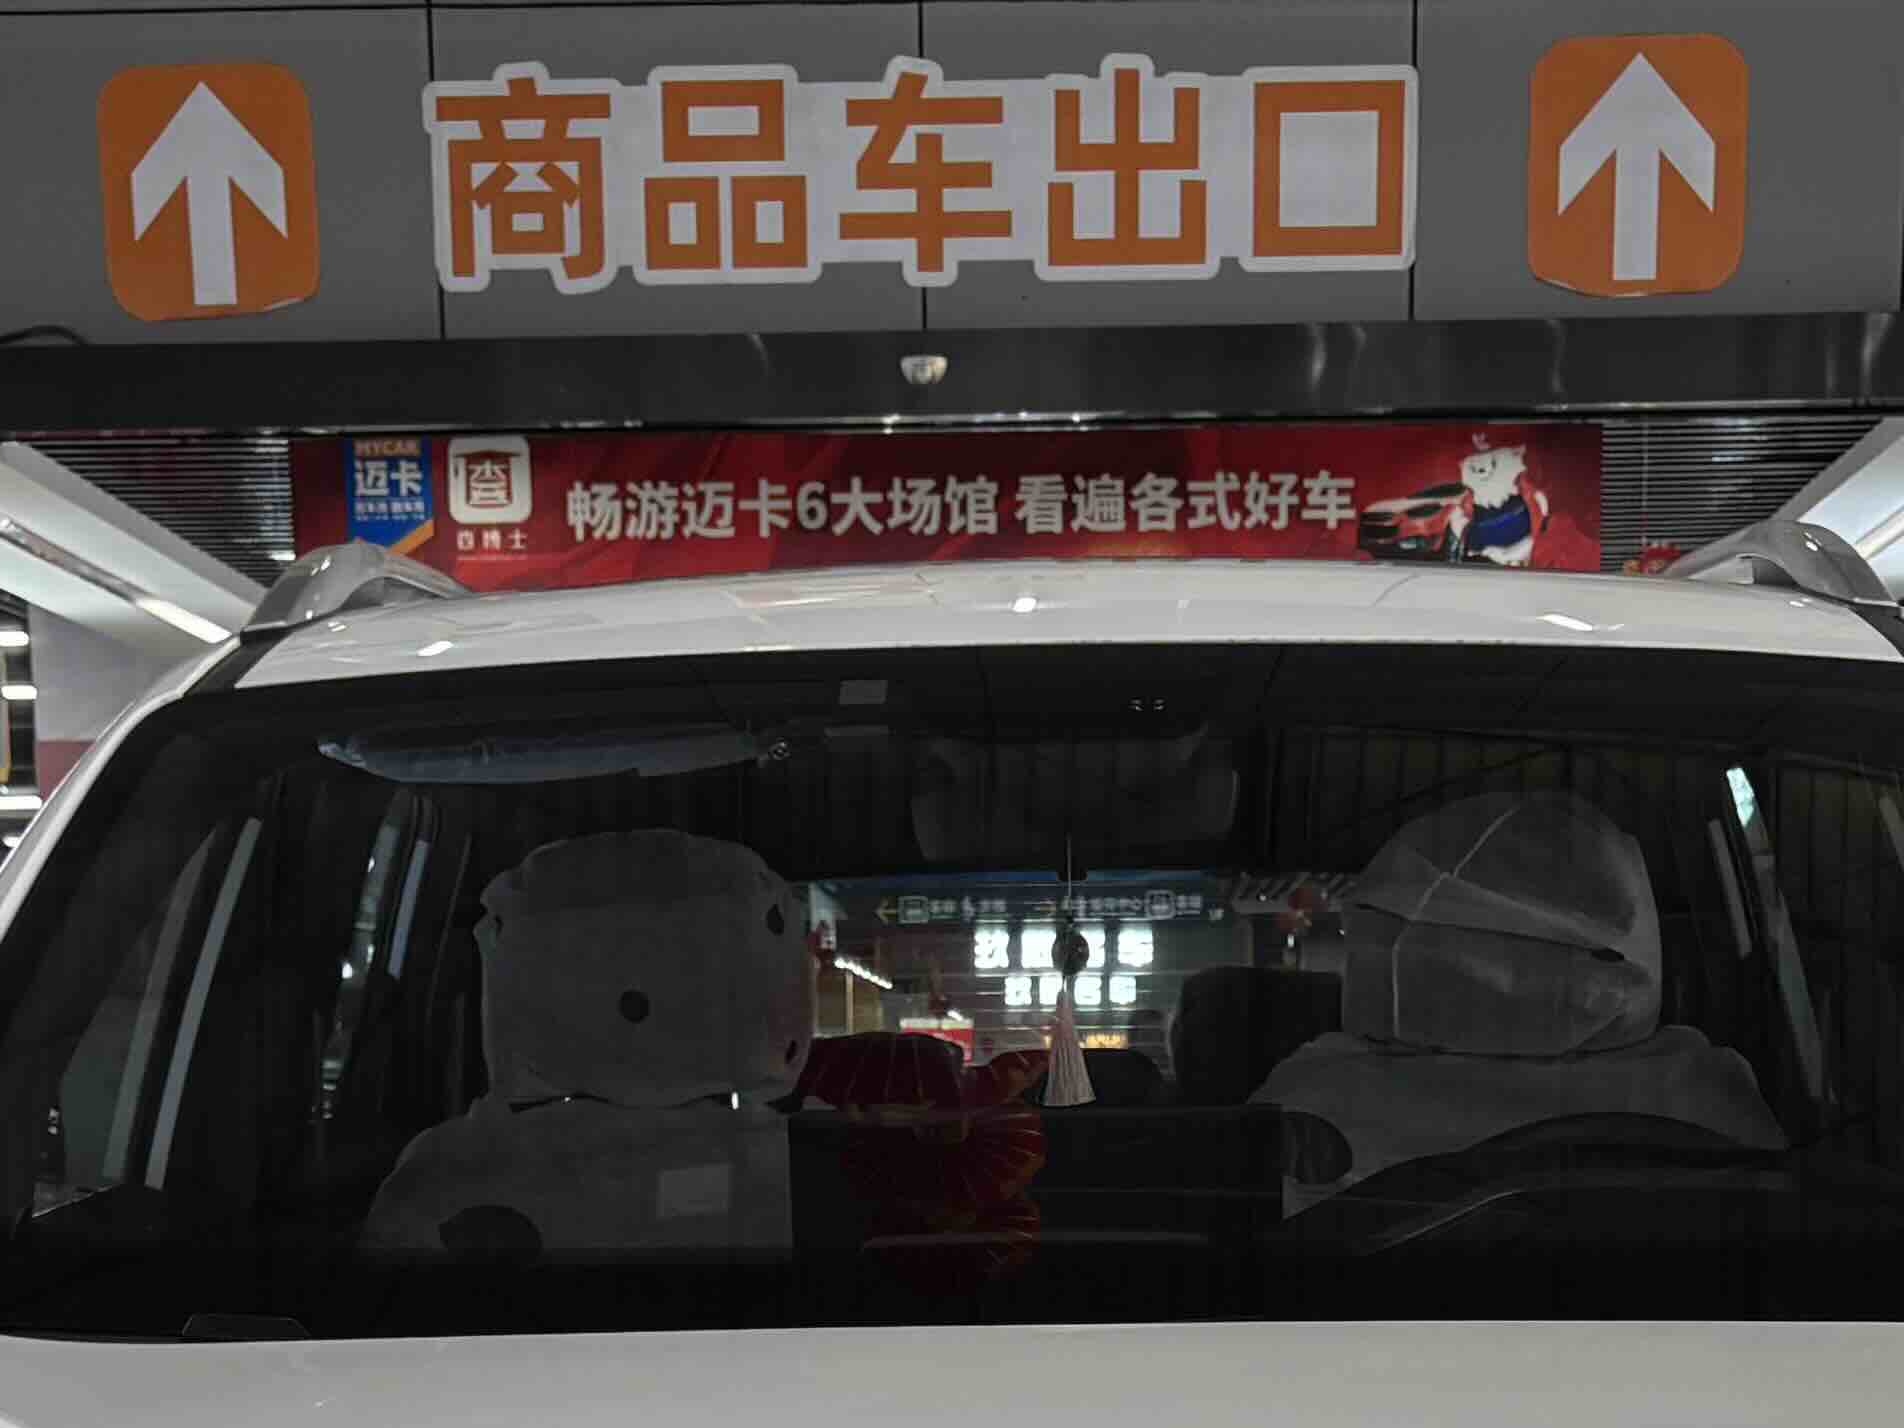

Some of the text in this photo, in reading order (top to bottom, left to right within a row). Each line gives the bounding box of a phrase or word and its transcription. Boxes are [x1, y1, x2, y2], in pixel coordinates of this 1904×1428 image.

[437, 70, 1405, 279] 商品车出口
[355, 460, 423, 497] 迈卡
[566, 472, 1357, 542] 畅游迈卡6大场馆 看遍各式好车
